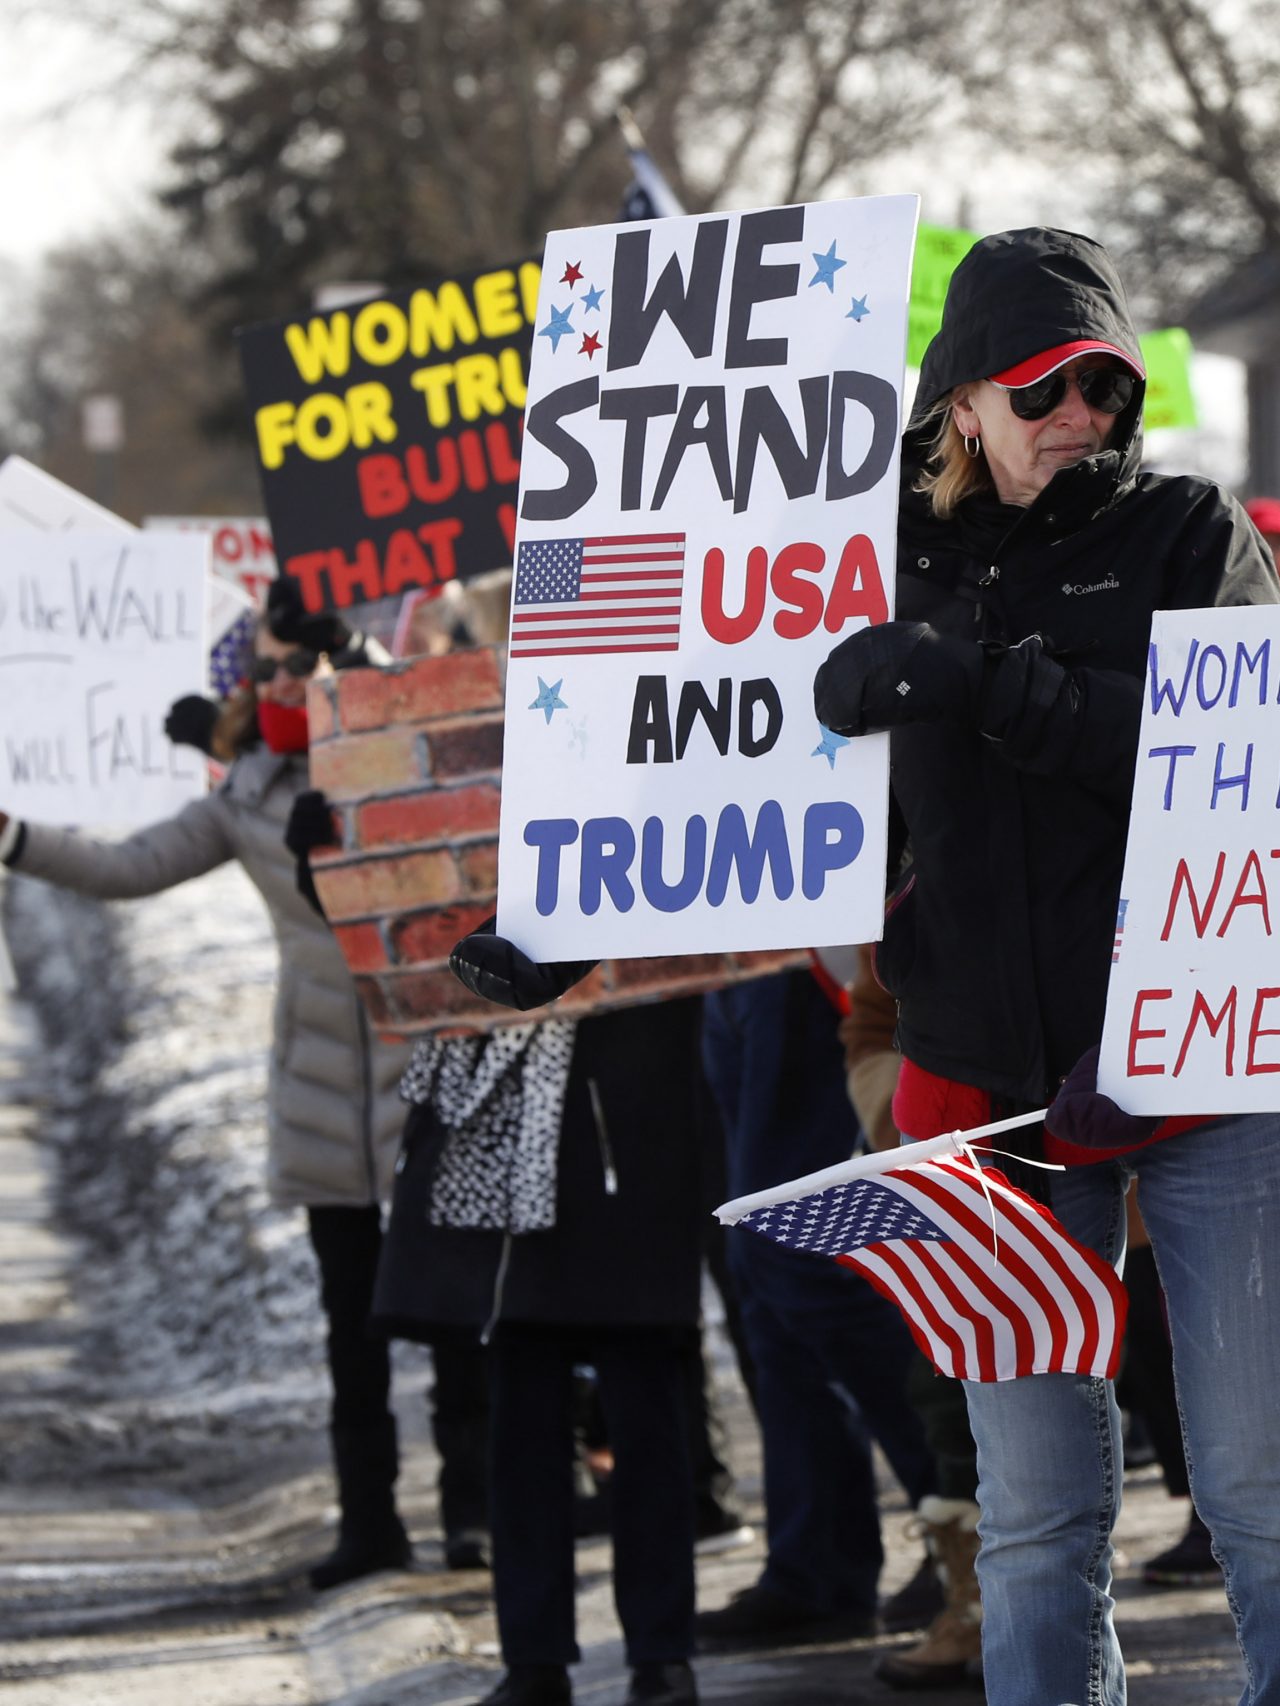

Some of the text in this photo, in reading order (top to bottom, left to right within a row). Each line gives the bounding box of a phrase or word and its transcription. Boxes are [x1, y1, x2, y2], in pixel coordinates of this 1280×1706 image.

[607, 206, 805, 372] WE
[256, 382, 397, 470] FOR
[357, 417, 525, 518] BUIL
[520, 371, 897, 520] STAND
[70, 546, 198, 643] WALL
[285, 517, 463, 613] THAT
[701, 534, 888, 644] USA
[1073, 578, 1120, 595] Columbia
[626, 675, 783, 764] AND
[523, 800, 864, 916] TRUMP
